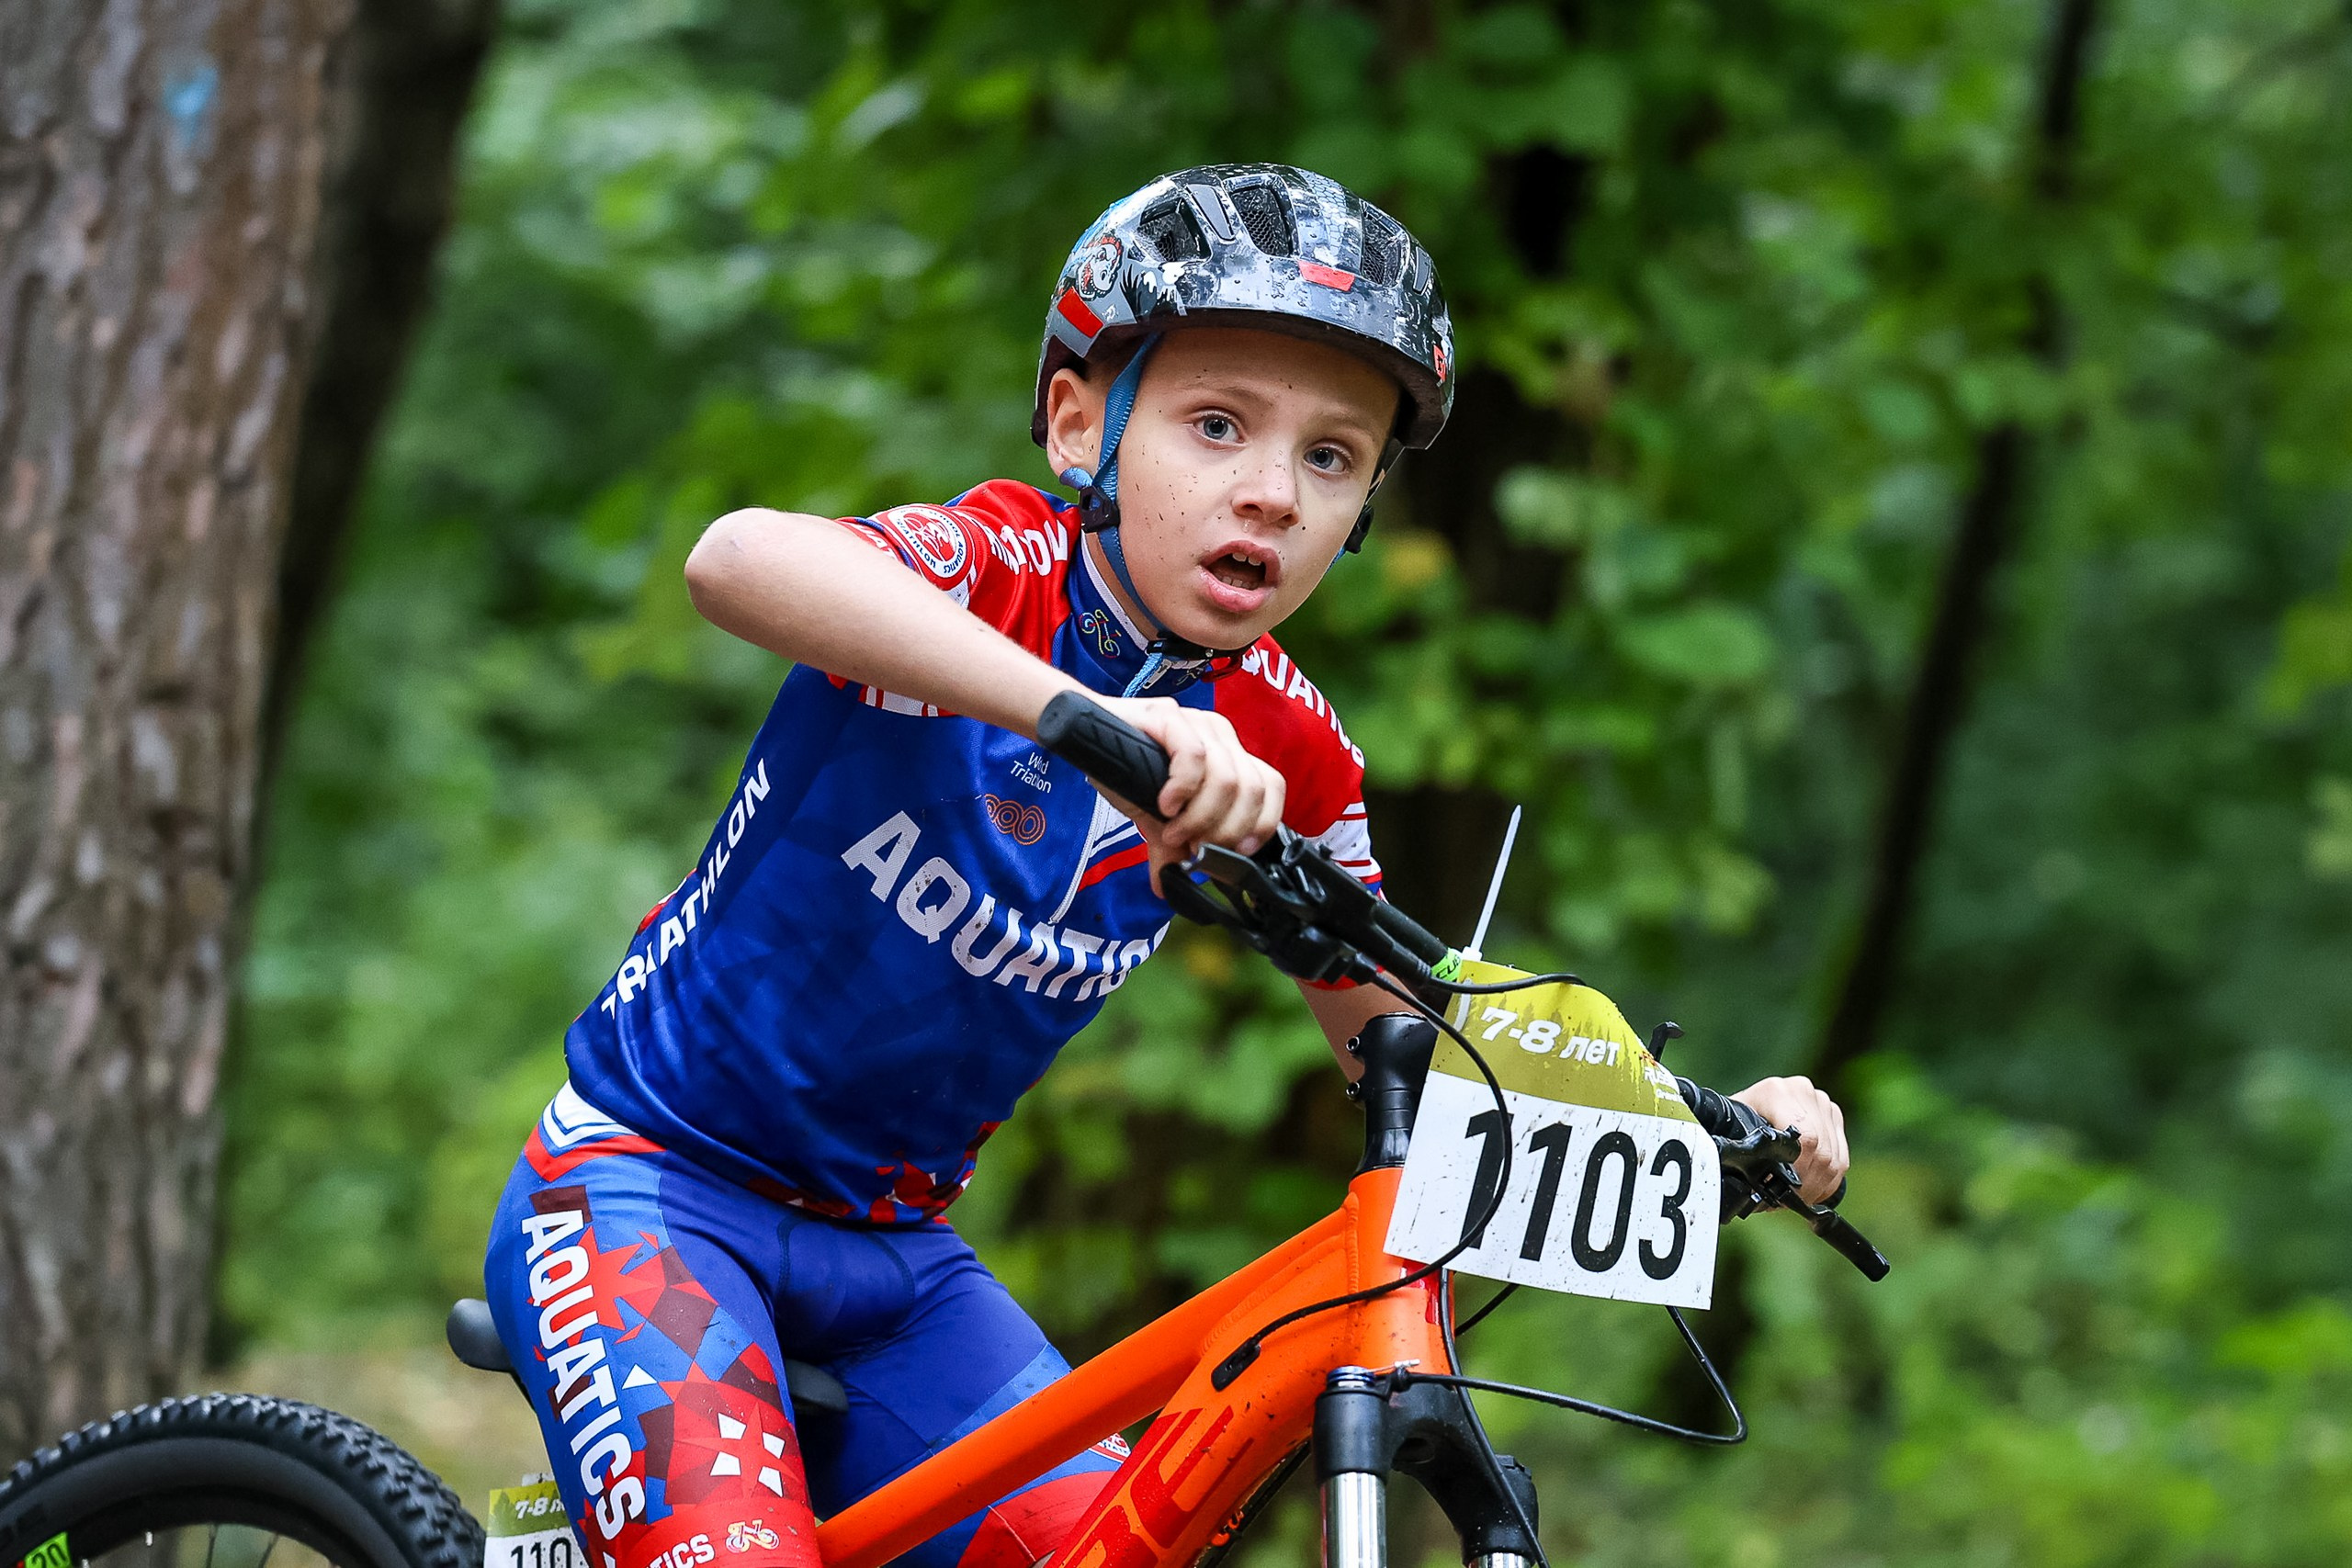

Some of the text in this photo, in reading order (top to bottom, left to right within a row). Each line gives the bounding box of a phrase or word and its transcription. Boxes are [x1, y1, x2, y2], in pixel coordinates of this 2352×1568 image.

[897, 517, 937, 569] RIATHLON
[601, 758, 771, 1020] TRIATHLON
[1480, 1006, 1621, 1067] 7-8 лет
[1459, 1109, 1692, 1280] 1103
[521, 1209, 646, 1540] AQUATICS
[514, 1497, 549, 1519] 7-8
